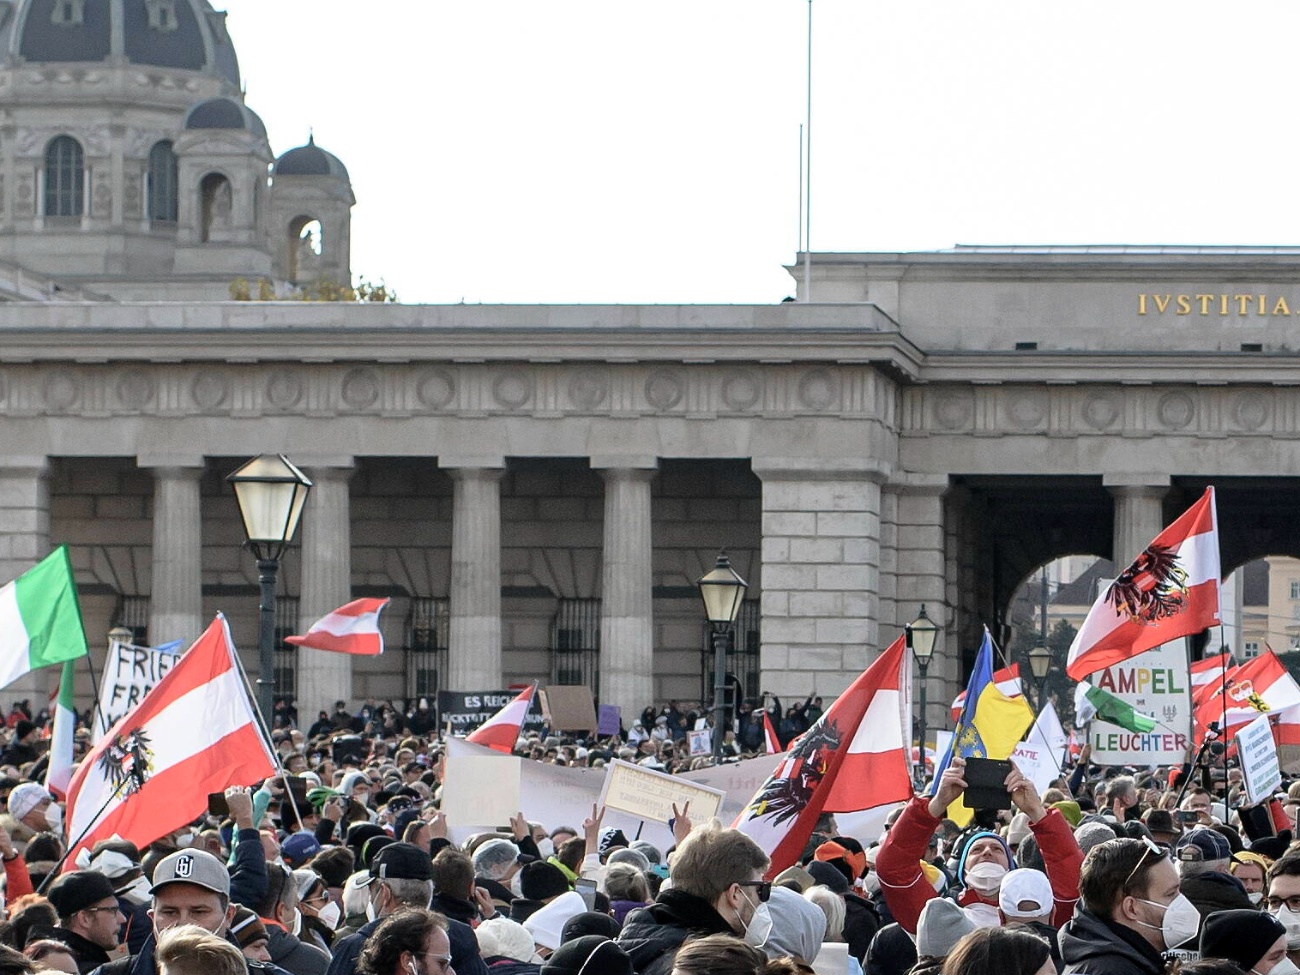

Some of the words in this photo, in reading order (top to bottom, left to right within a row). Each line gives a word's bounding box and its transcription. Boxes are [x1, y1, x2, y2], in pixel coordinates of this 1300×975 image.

[1098, 667, 1184, 694] AMPEL
[464, 696, 481, 708] ES
[1095, 733, 1188, 752] LEUCHTER
[1011, 747, 1039, 760] RATIE
